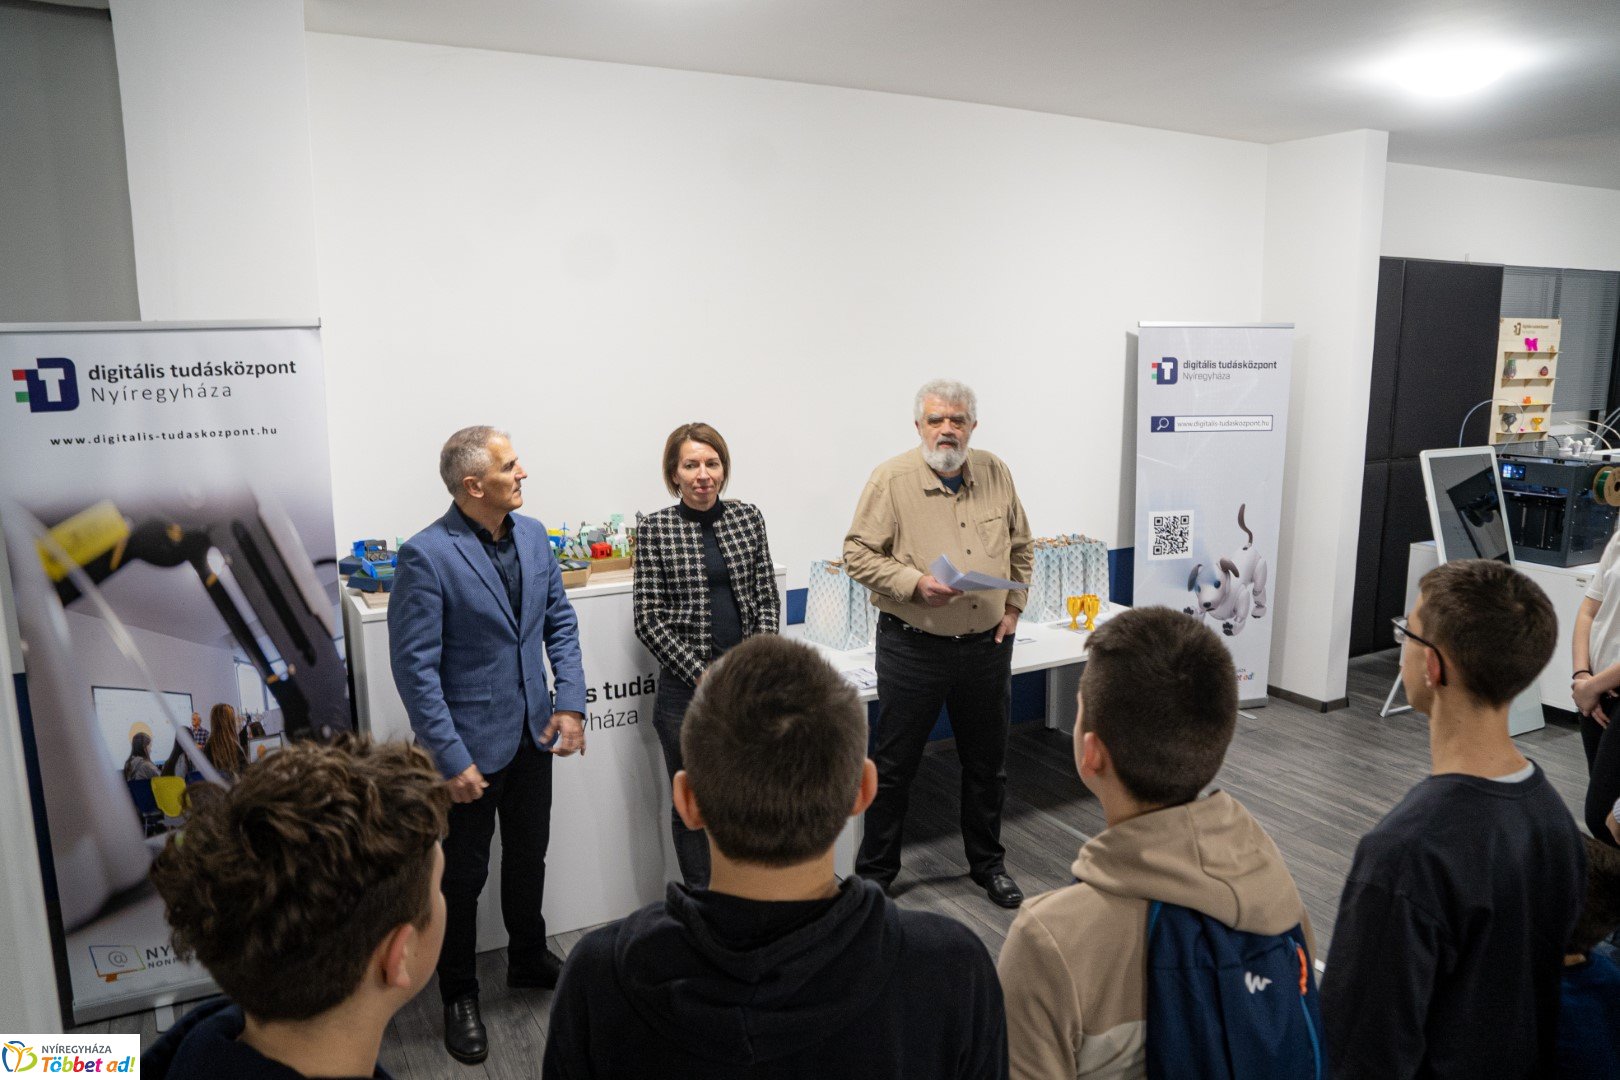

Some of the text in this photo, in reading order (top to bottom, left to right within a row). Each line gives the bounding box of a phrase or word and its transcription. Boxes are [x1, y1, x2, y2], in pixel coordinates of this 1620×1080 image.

[88, 360, 297, 383] digitális tudásközpont
[1183, 359, 1277, 371] digitális tudásközpont
[91, 384, 232, 405] Nyíregyháza
[50, 427, 278, 446] www.digitalis-tudaskozpont.hu
[603, 673, 656, 700] tudá
[583, 709, 639, 731] háza
[146, 944, 171, 960] NY
